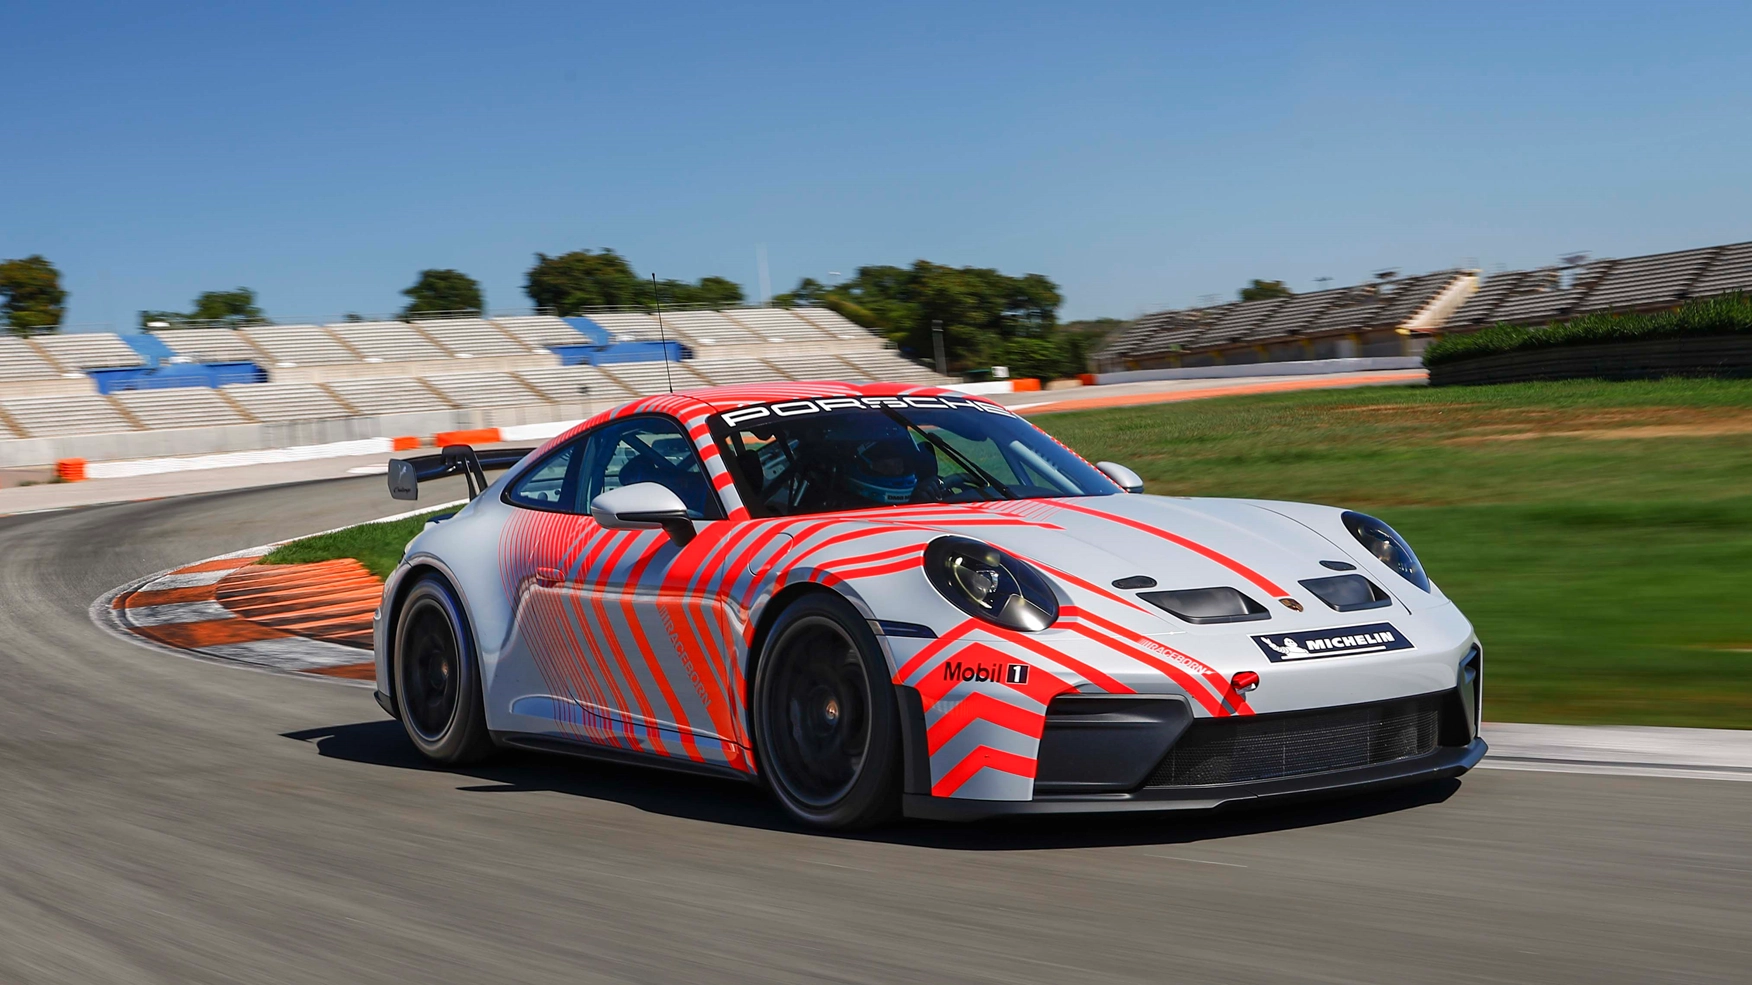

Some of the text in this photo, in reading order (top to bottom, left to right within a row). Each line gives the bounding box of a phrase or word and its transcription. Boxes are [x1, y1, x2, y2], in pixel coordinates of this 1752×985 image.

[720, 396, 1017, 428] PORSCHE
[1305, 631, 1395, 651] MICHELIN
[666, 620, 712, 707] RACEBORN
[943, 661, 1003, 682] Mobil
[1148, 642, 1209, 675] RACEBORN
